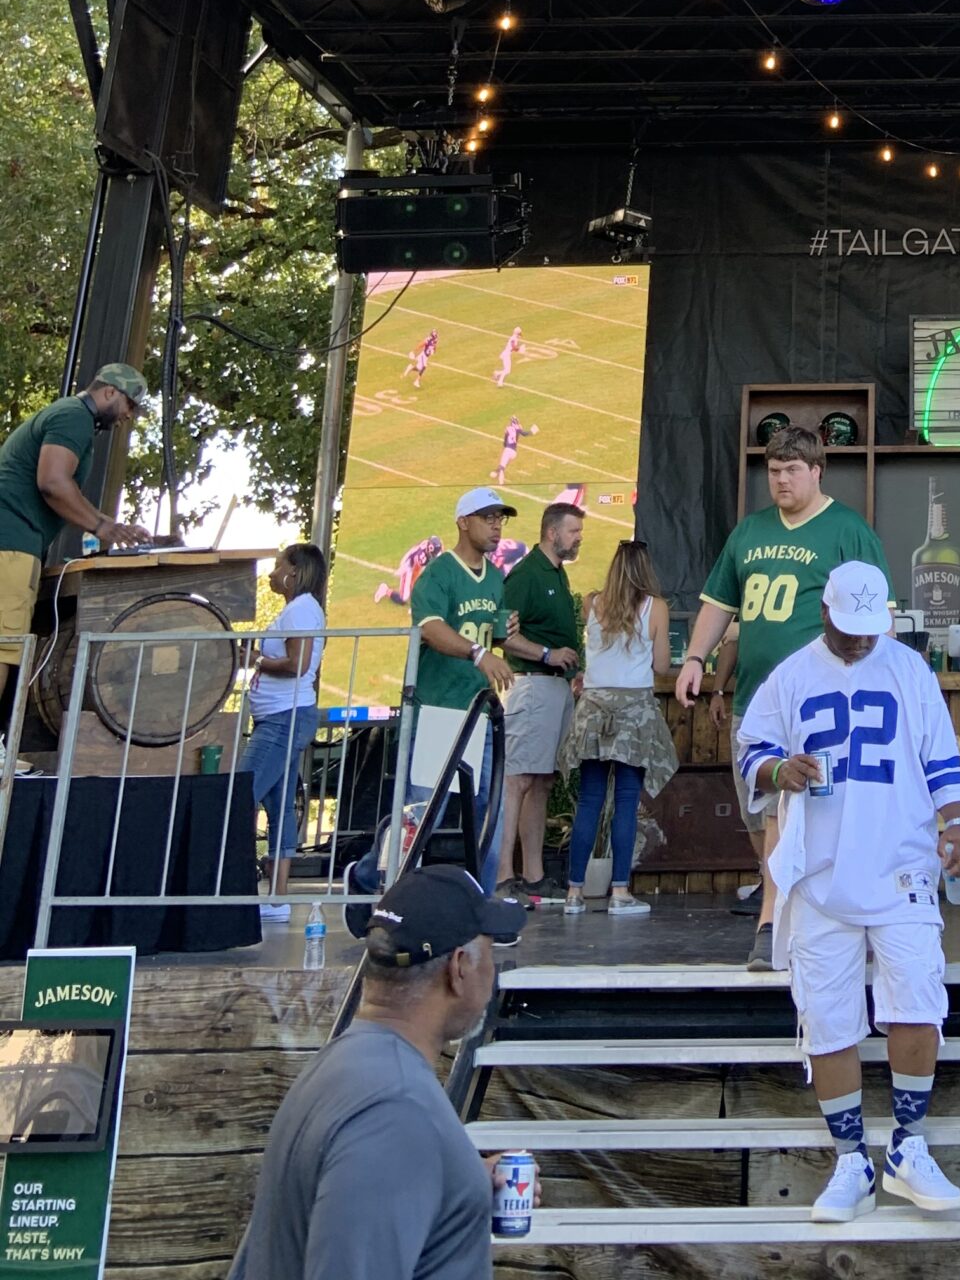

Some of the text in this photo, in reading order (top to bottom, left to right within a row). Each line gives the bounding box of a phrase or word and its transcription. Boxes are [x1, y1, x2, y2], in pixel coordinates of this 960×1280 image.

[914, 571, 960, 587] JAMESON
[742, 573, 799, 622] 80
[800, 689, 898, 785] 22
[14, 1183, 43, 1195] OUR
[11, 1199, 76, 1211] STARTING
[9, 1216, 60, 1227] LINEUP.
[7, 1232, 51, 1245] TASTE,
[5, 1247, 85, 1261] THAT'S WHY
